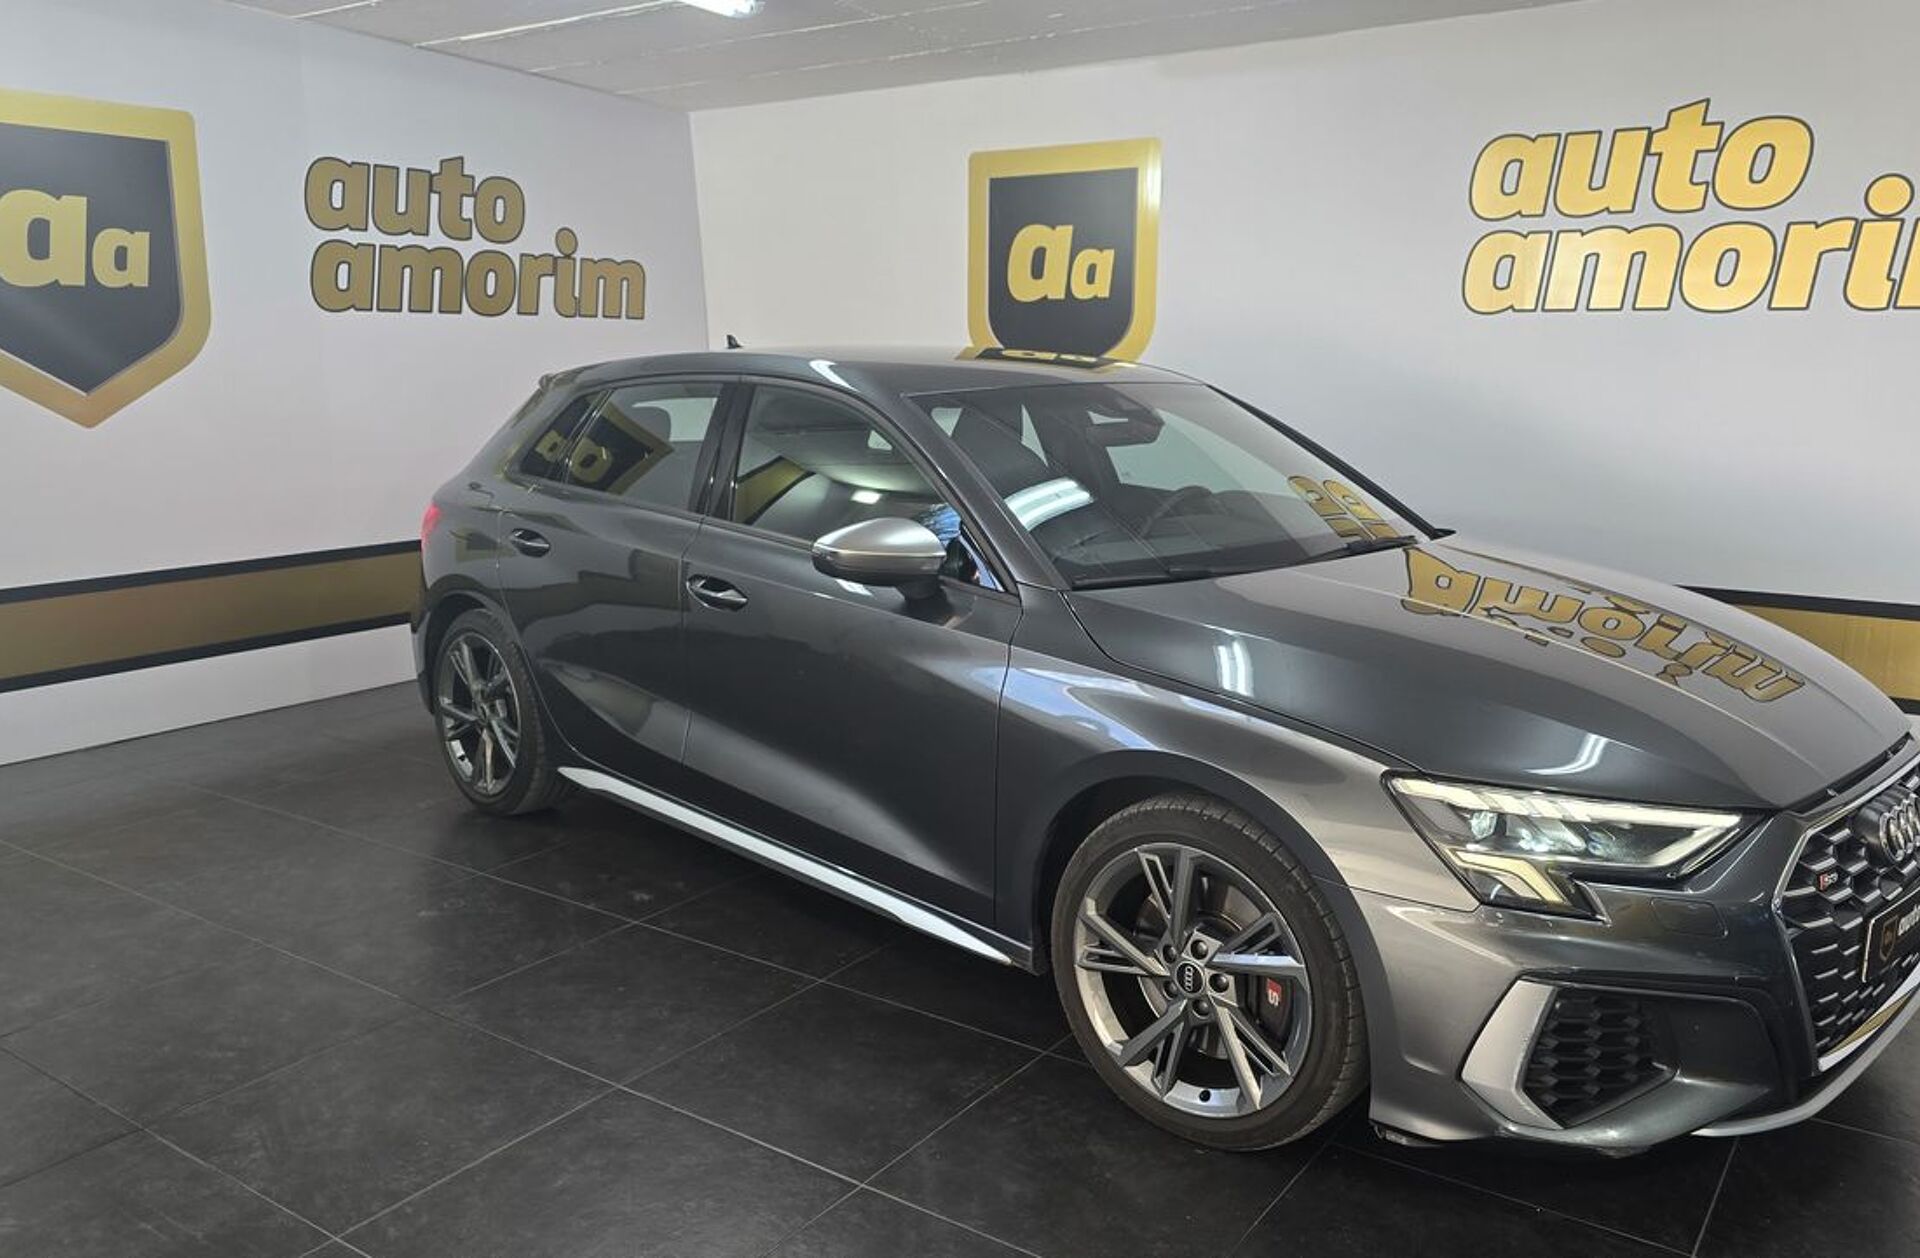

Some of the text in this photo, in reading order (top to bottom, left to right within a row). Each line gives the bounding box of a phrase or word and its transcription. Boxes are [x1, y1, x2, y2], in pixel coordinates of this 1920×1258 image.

[304, 155, 525, 243] auto
[1468, 98, 1814, 221] auto
[310, 227, 646, 320] amorim
[1462, 173, 1920, 314] amori
